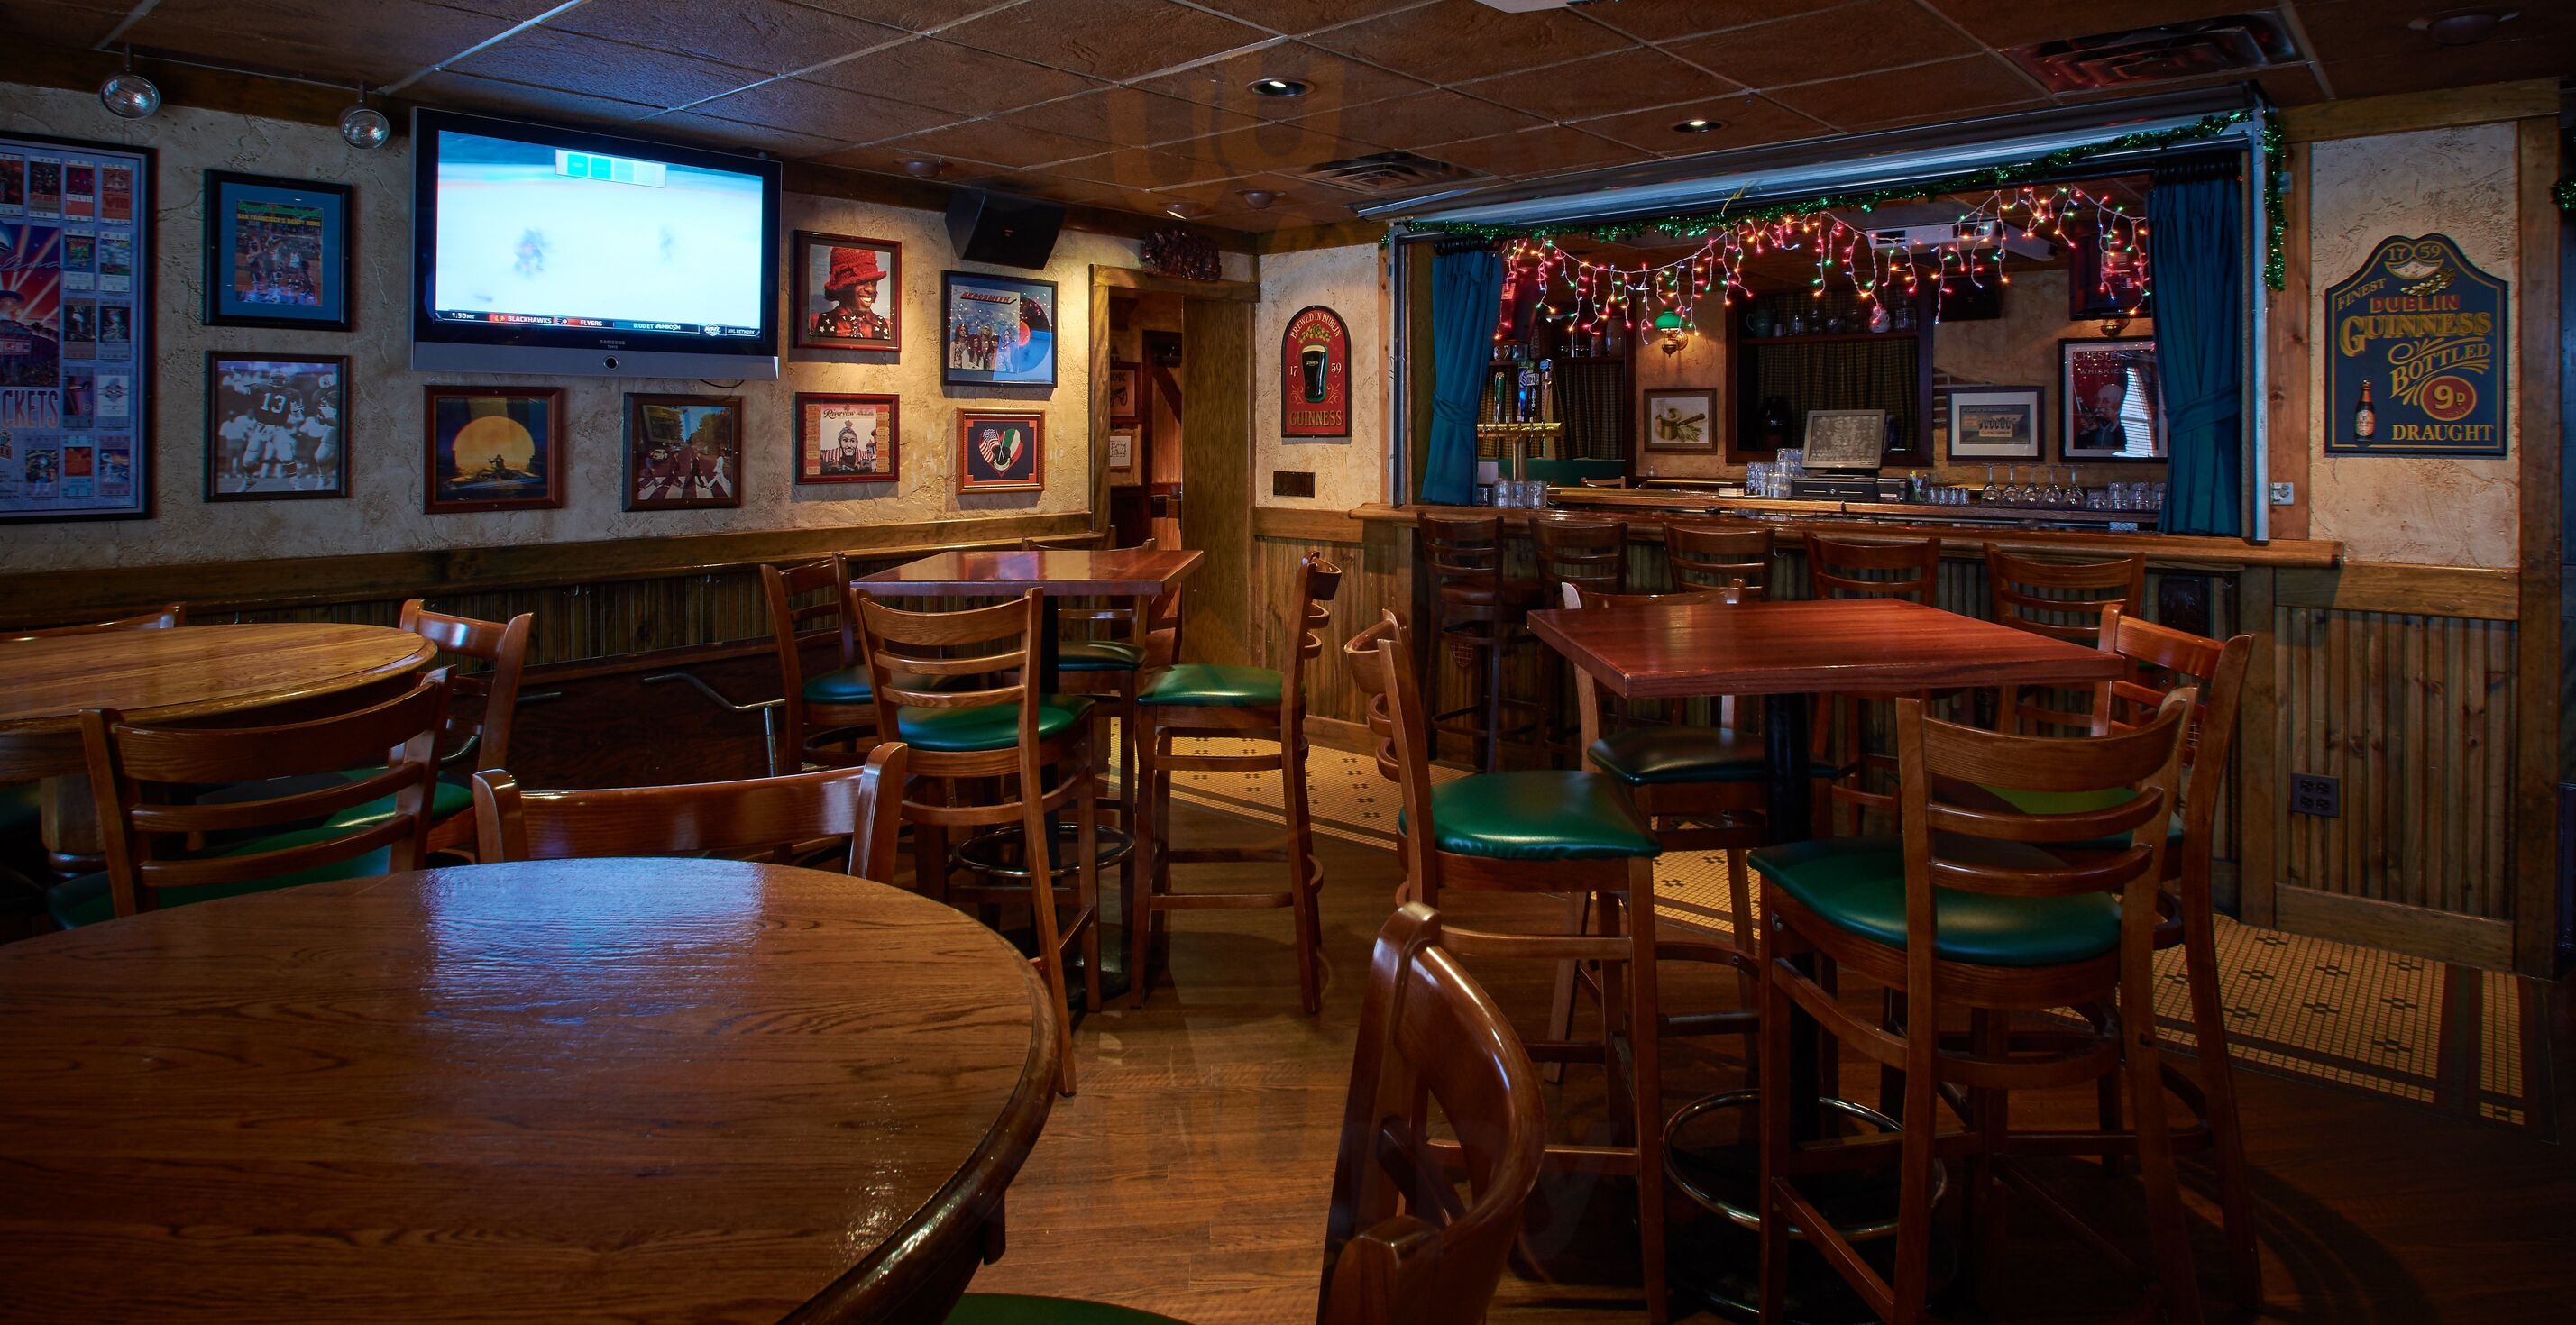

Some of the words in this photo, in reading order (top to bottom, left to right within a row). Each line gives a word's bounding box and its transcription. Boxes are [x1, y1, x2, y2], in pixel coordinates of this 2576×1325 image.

[2389, 247, 2406, 260] 17
[2420, 246, 2441, 259] 59
[2337, 278, 2386, 311] FINEST
[2370, 295, 2460, 313] DUBLIN
[508, 315, 552, 324] BLACKHAWKS
[1290, 313, 1314, 339] BREWED
[1315, 312, 1322, 320] IN
[1322, 314, 1341, 337] DUBLIN
[2339, 312, 2493, 357] GUINNESS
[1290, 366, 1298, 377] 17
[1331, 362, 1342, 374] 59
[2389, 343, 2491, 399] BOTTLED
[2, 389, 59, 428] CKETS
[261, 392, 287, 414] 13
[823, 409, 856, 420] Riverview
[1289, 410, 1343, 426] GUINNESS
[2391, 424, 2495, 442] DRAUGHT
